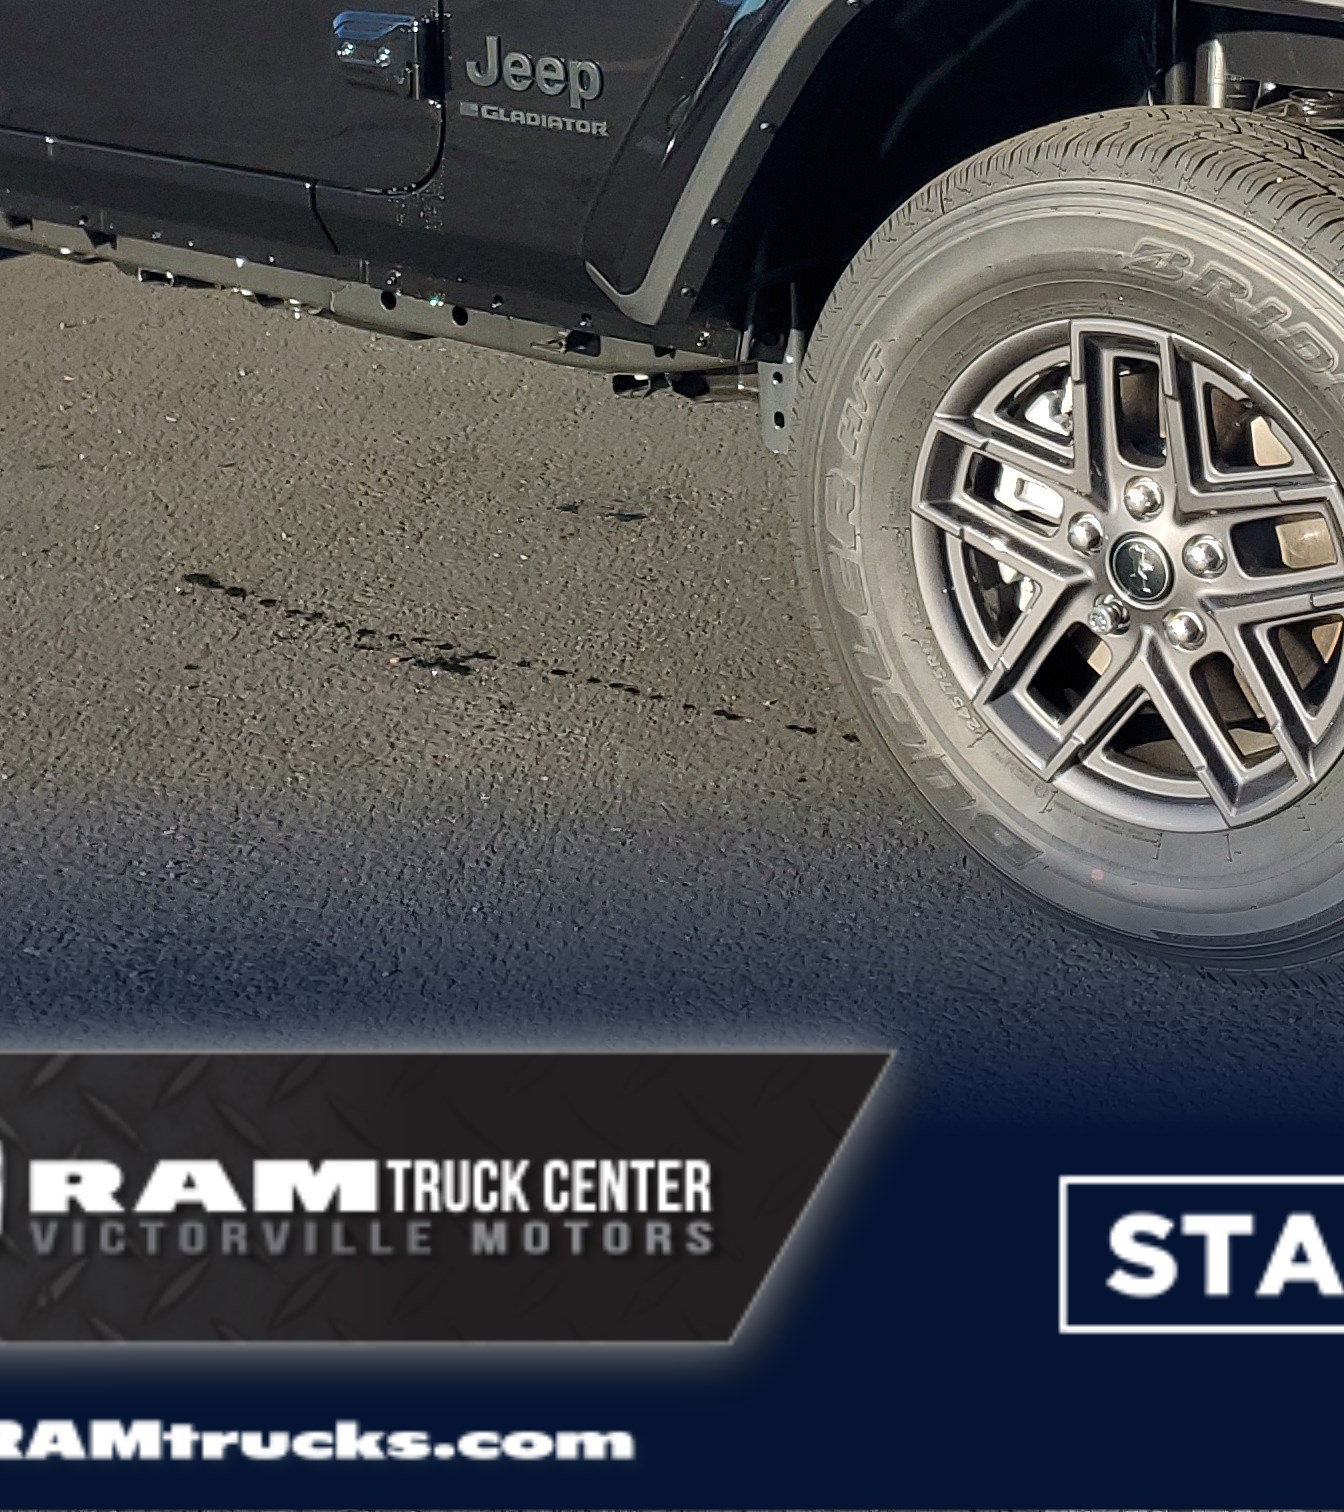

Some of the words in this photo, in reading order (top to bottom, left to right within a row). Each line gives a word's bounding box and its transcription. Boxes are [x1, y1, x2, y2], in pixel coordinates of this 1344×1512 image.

[465, 35, 603, 110] Jeep
[480, 104, 610, 138] GLADIATOR
[826, 468, 1046, 867] DUELER
